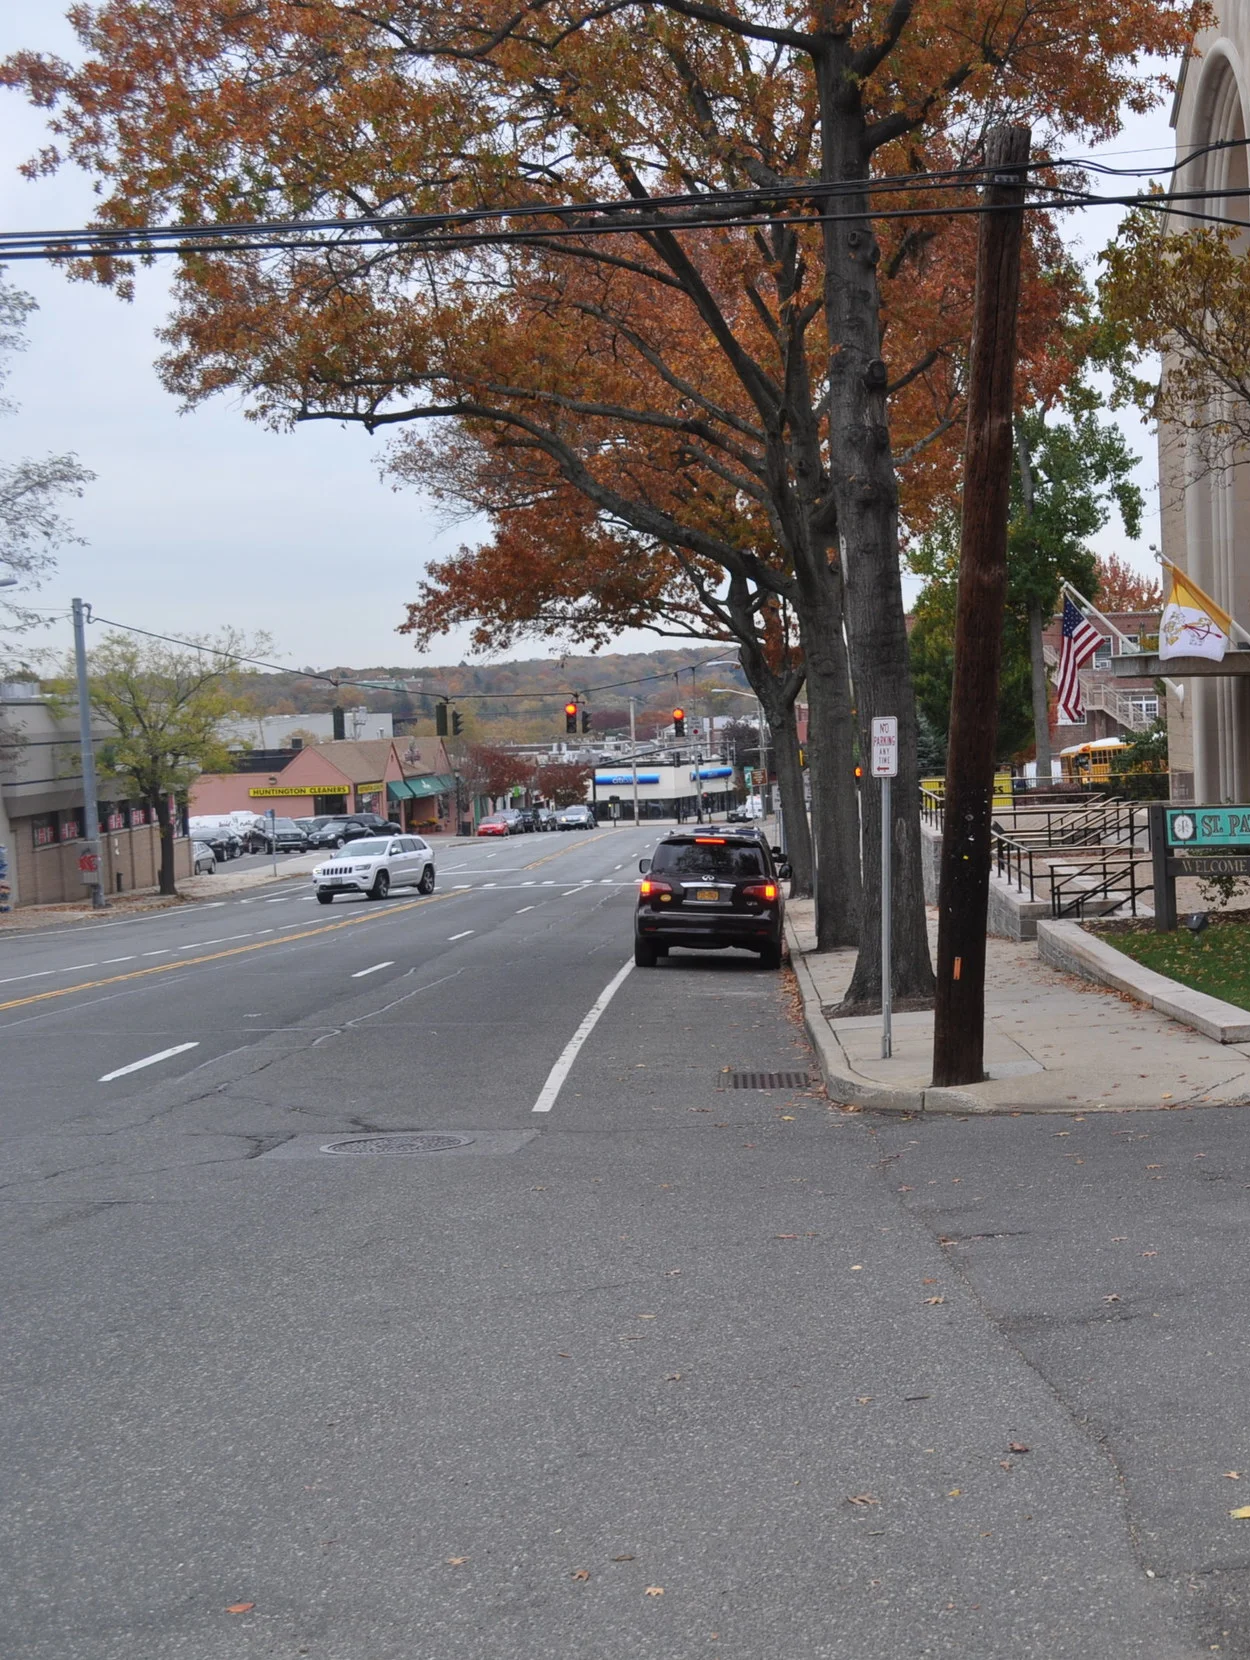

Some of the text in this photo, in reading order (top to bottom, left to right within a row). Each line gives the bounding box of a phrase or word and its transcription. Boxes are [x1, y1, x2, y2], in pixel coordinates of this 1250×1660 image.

[880, 722, 889, 733] NO
[873, 736, 895, 746] PARKING
[252, 787, 306, 796] HUNTINGTON
[309, 786, 347, 795] CLEANERS
[1201, 814, 1223, 837] ST.
[1182, 858, 1248, 873] WELCOME
